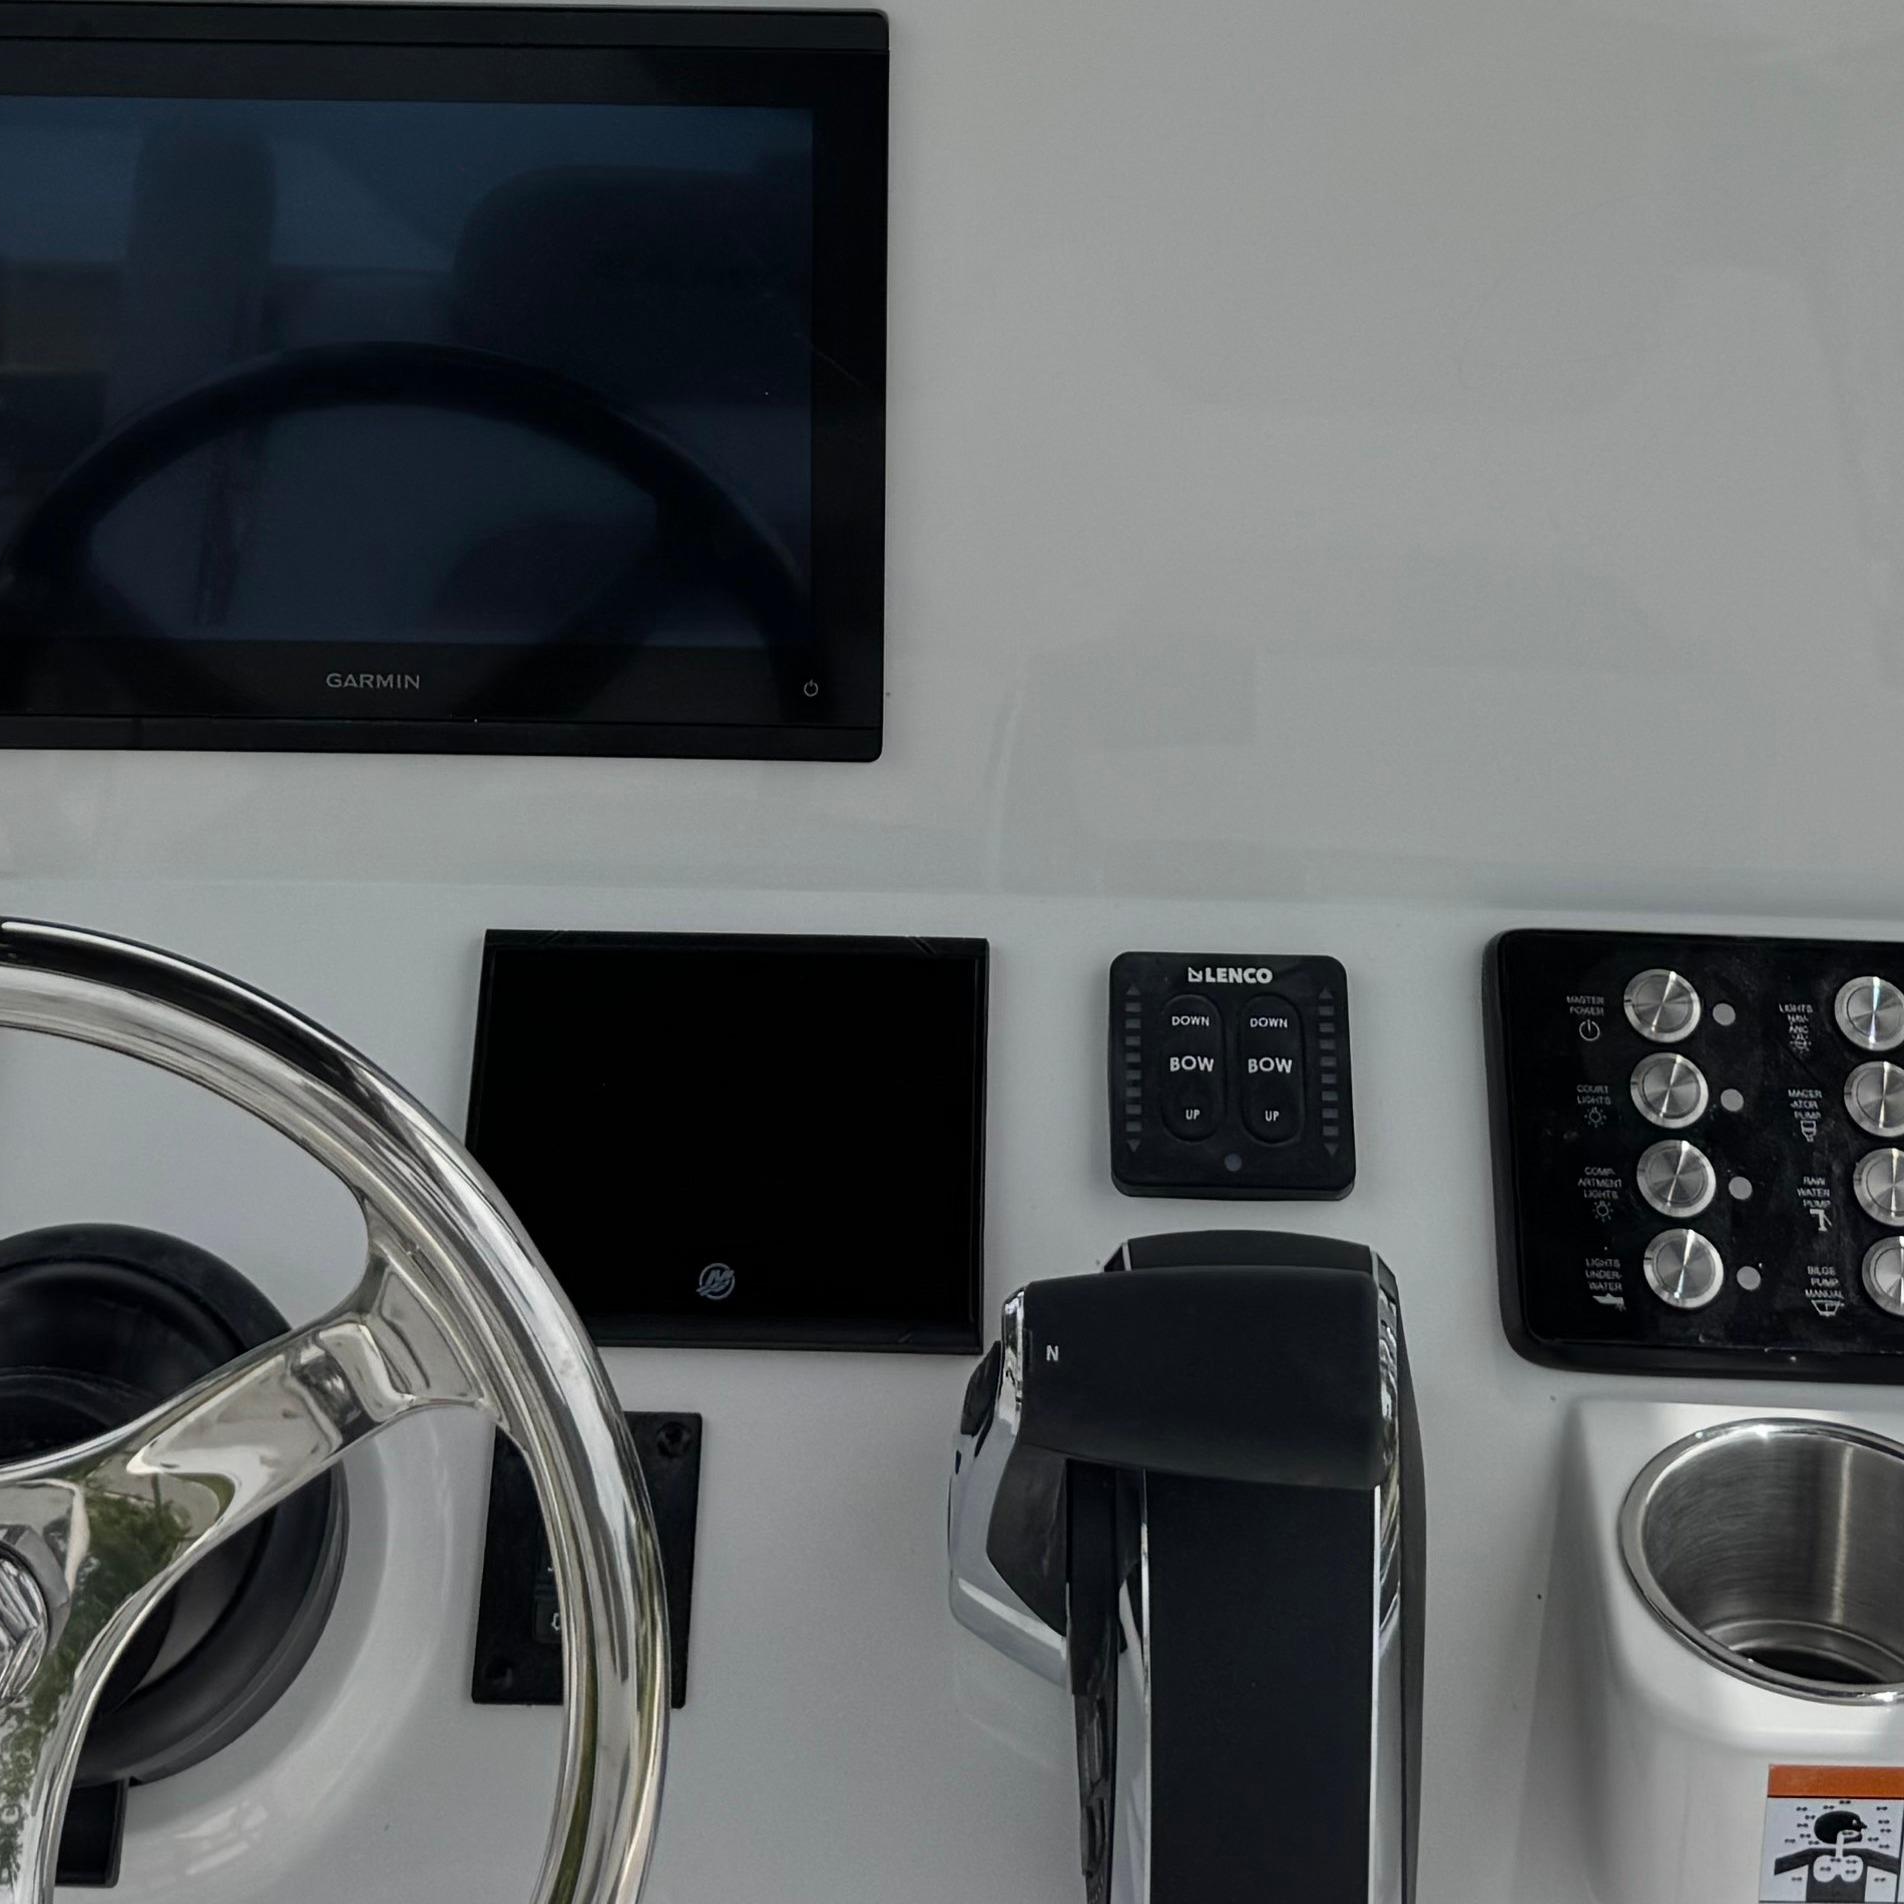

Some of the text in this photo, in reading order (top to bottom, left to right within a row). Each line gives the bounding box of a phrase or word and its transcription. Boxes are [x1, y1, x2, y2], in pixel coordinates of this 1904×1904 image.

[325, 672, 421, 689] GARMIN
[1205, 967, 1273, 984] LENCO
[1171, 1015, 1288, 1029] DOWN DOWN
[1169, 1055, 1293, 1074] BOW BOW
[1576, 1095, 1612, 1106] LIGHTS
[1185, 1109, 1280, 1122] UP UP
[1794, 1111, 1822, 1121] PUMP
[1803, 1176, 1825, 1186] RAW
[1583, 1189, 1619, 1200] LIGHTS
[1797, 1187, 1830, 1197] WATER
[1802, 1199, 1831, 1209] PUMP
[1585, 1257, 1621, 1268] LIGHTS
[1588, 1280, 1622, 1291] WATER
[1811, 1277, 1839, 1287] PUMP
[1805, 1289, 1844, 1299] MANUAL
[1046, 1344, 1059, 1361] N
